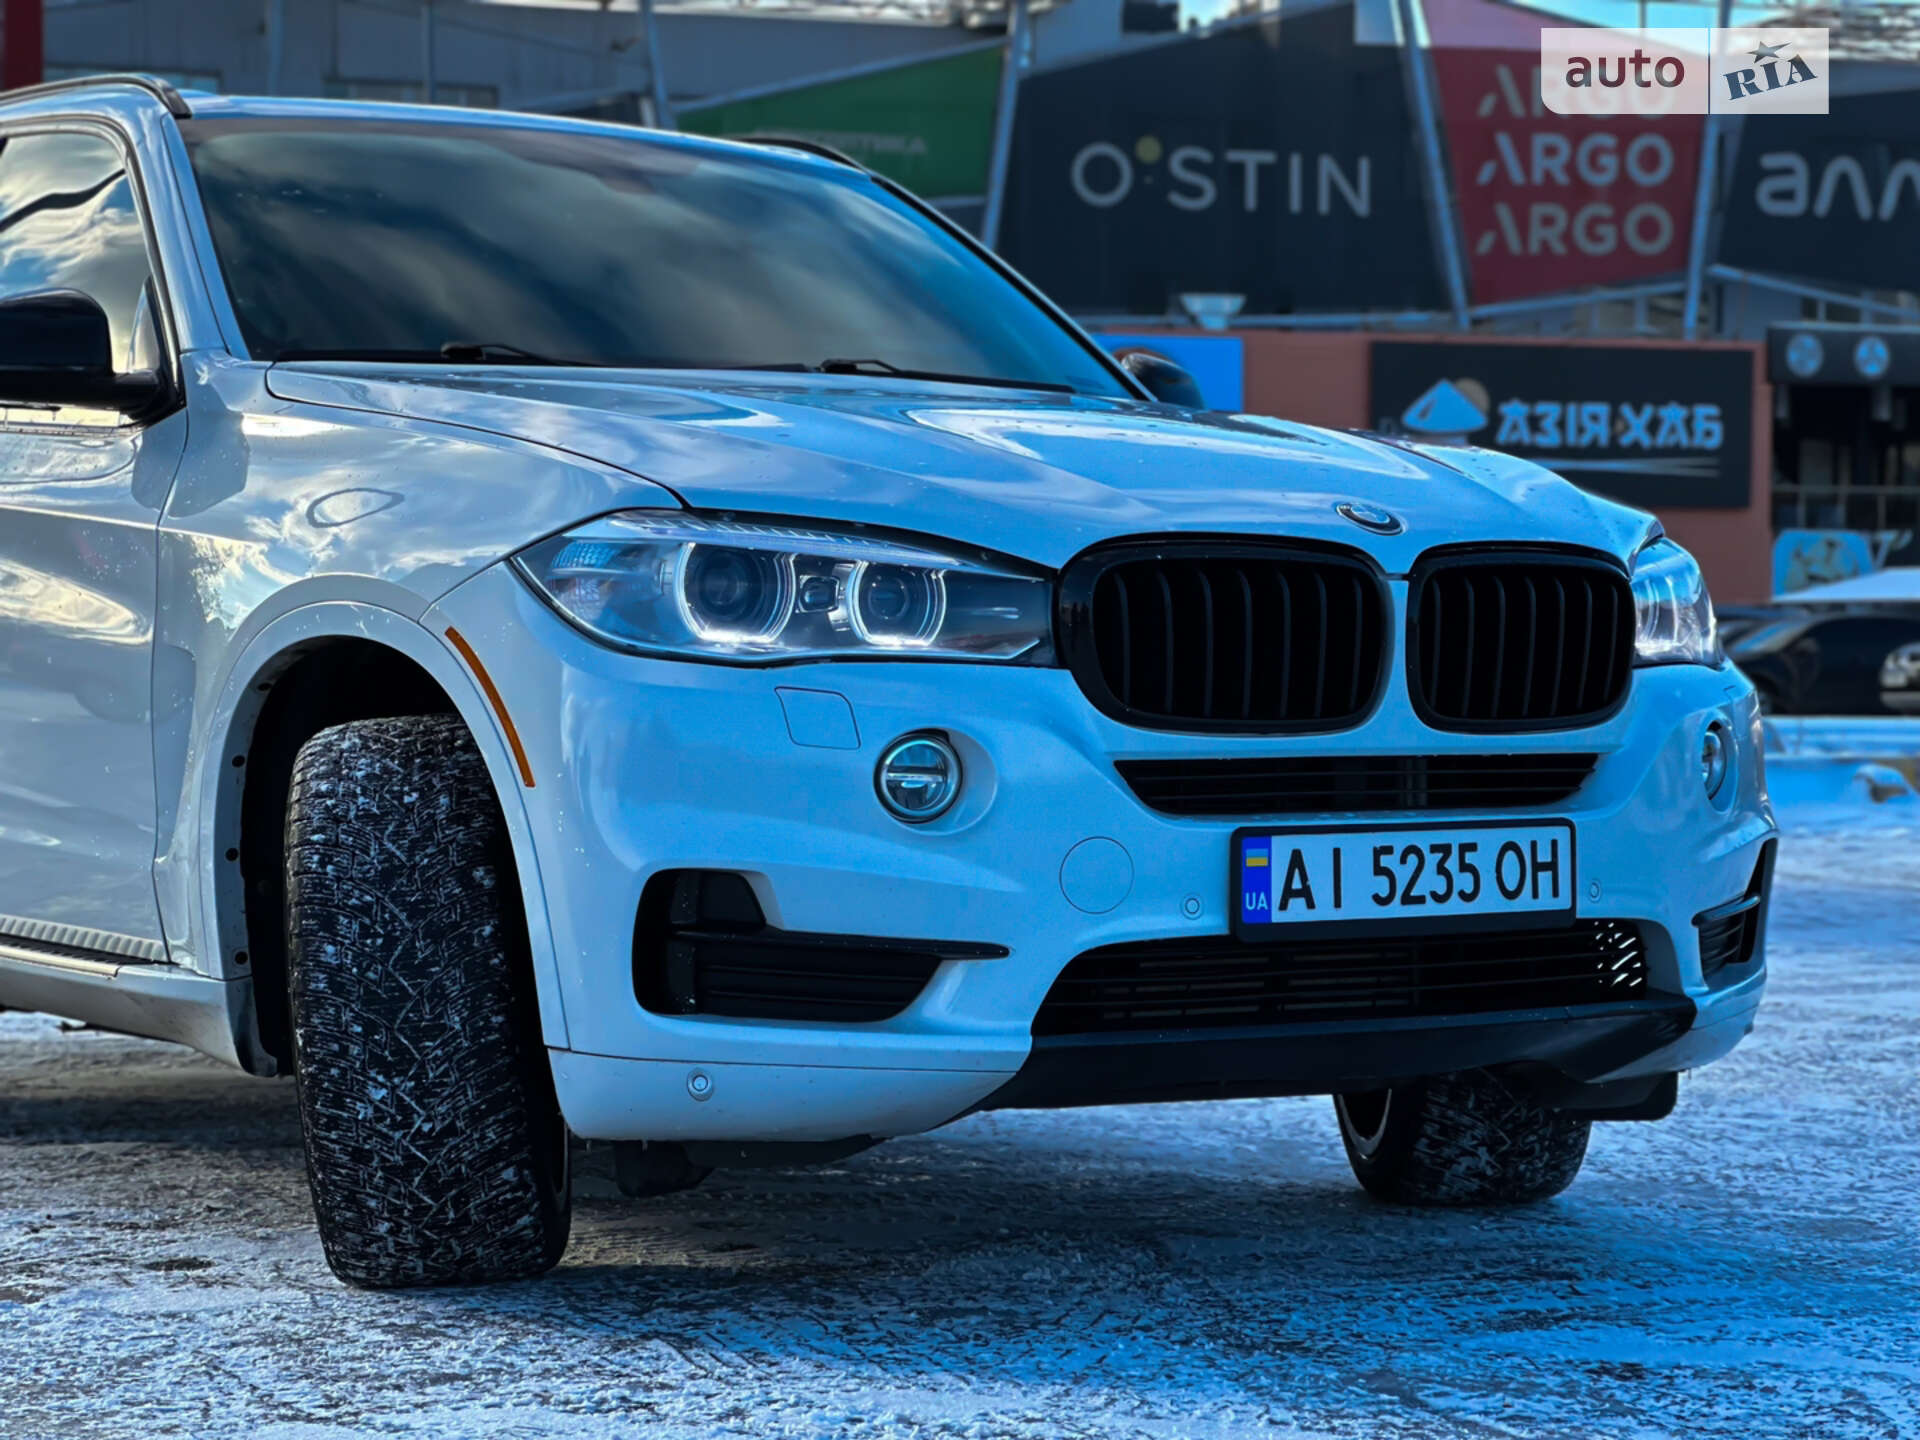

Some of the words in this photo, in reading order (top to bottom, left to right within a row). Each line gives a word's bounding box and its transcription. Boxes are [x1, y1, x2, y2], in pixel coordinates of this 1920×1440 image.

[1476, 132, 1674, 186] ARGO
[1475, 203, 1674, 255] ARGO
[1496, 397, 1611, 447] АЗІЯ
[1617, 401, 1724, 449] ХАБ
[1278, 847, 1343, 911] AI
[1370, 842, 1481, 906] 5235
[1495, 838, 1560, 901] OH
[1245, 892, 1269, 911] UA
